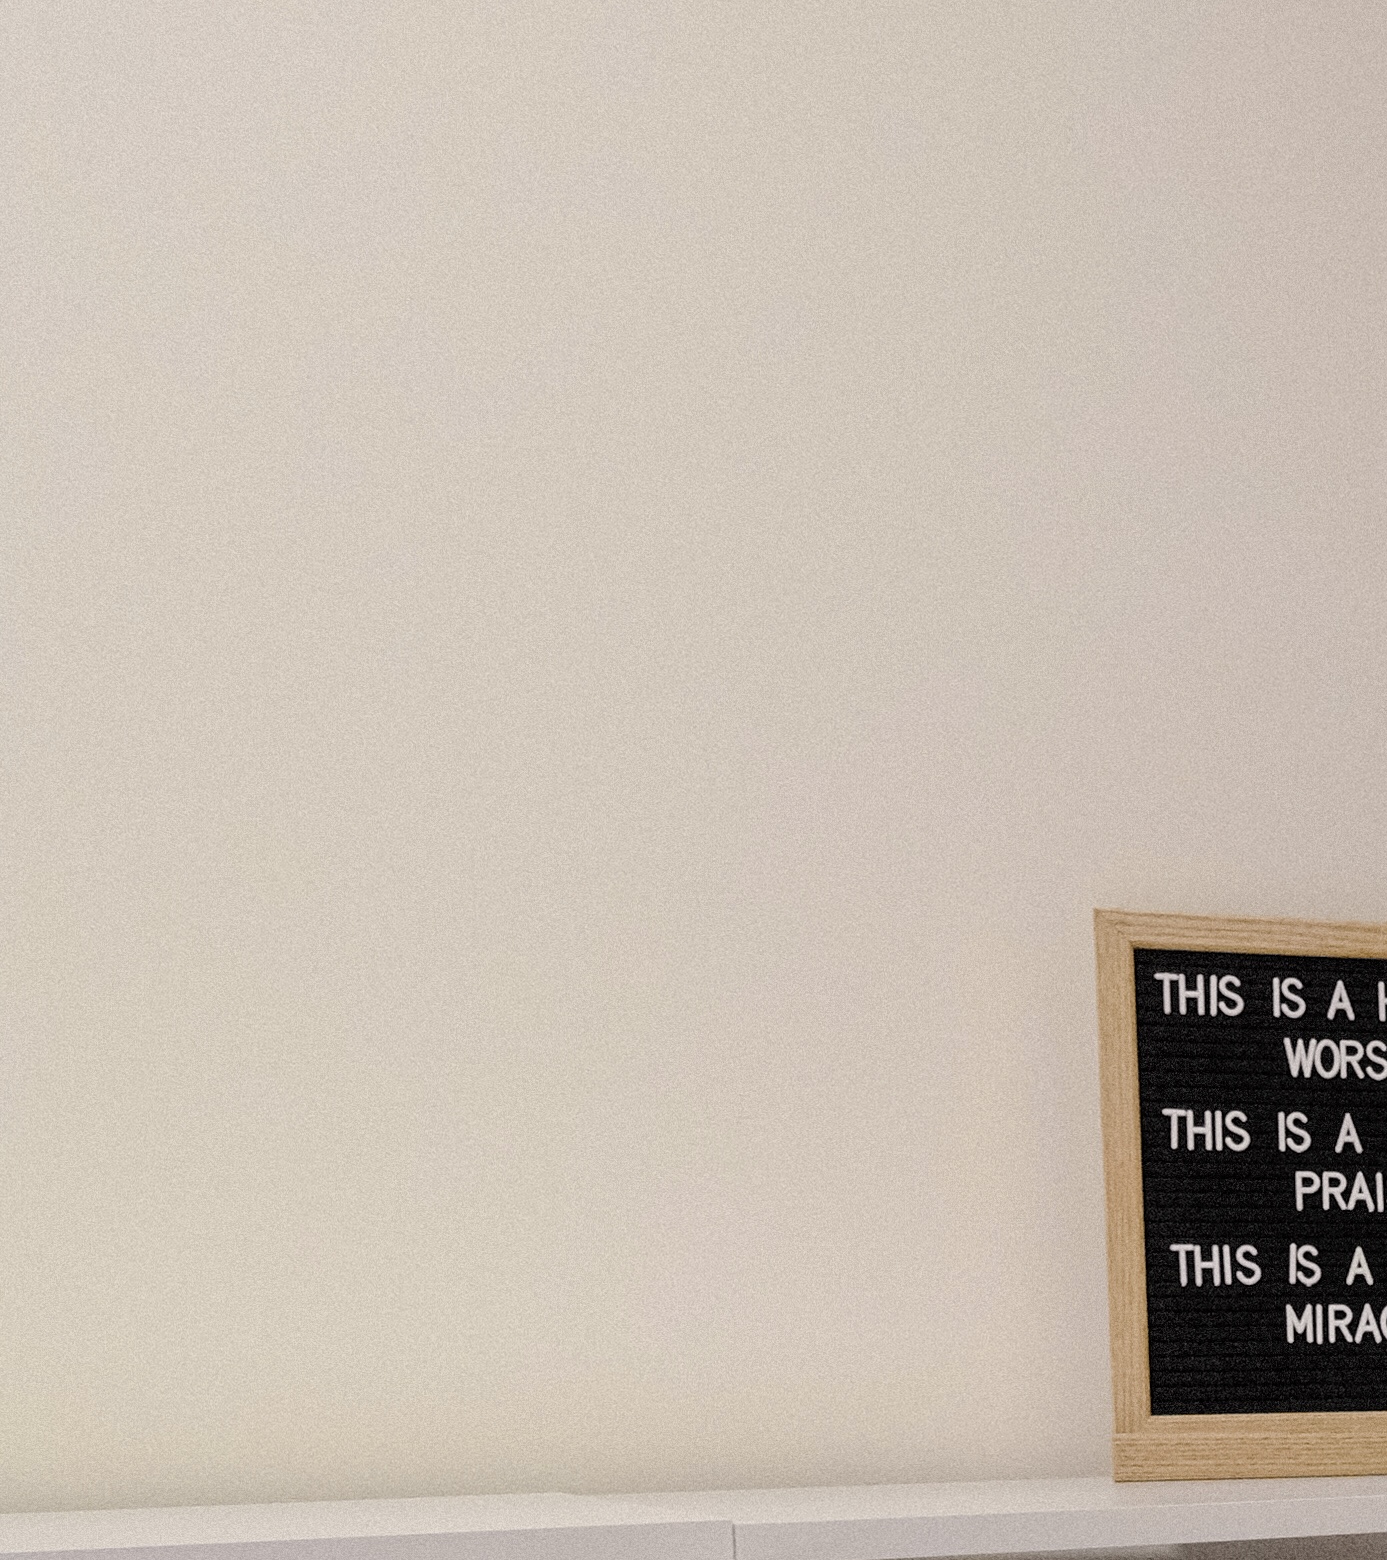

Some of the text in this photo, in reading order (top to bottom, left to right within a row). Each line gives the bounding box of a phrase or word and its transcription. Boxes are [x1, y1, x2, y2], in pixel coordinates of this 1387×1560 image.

[1154, 972, 1245, 1017] THIS
[1272, 977, 1306, 1020] IS
[1327, 980, 1355, 1021] A
[1162, 1108, 1251, 1152] THIS
[1277, 1111, 1312, 1153] IS
[1335, 1113, 1363, 1154] A
[1170, 1243, 1262, 1287] THIS
[1289, 1243, 1322, 1287] IS
[1346, 1246, 1374, 1286] A
